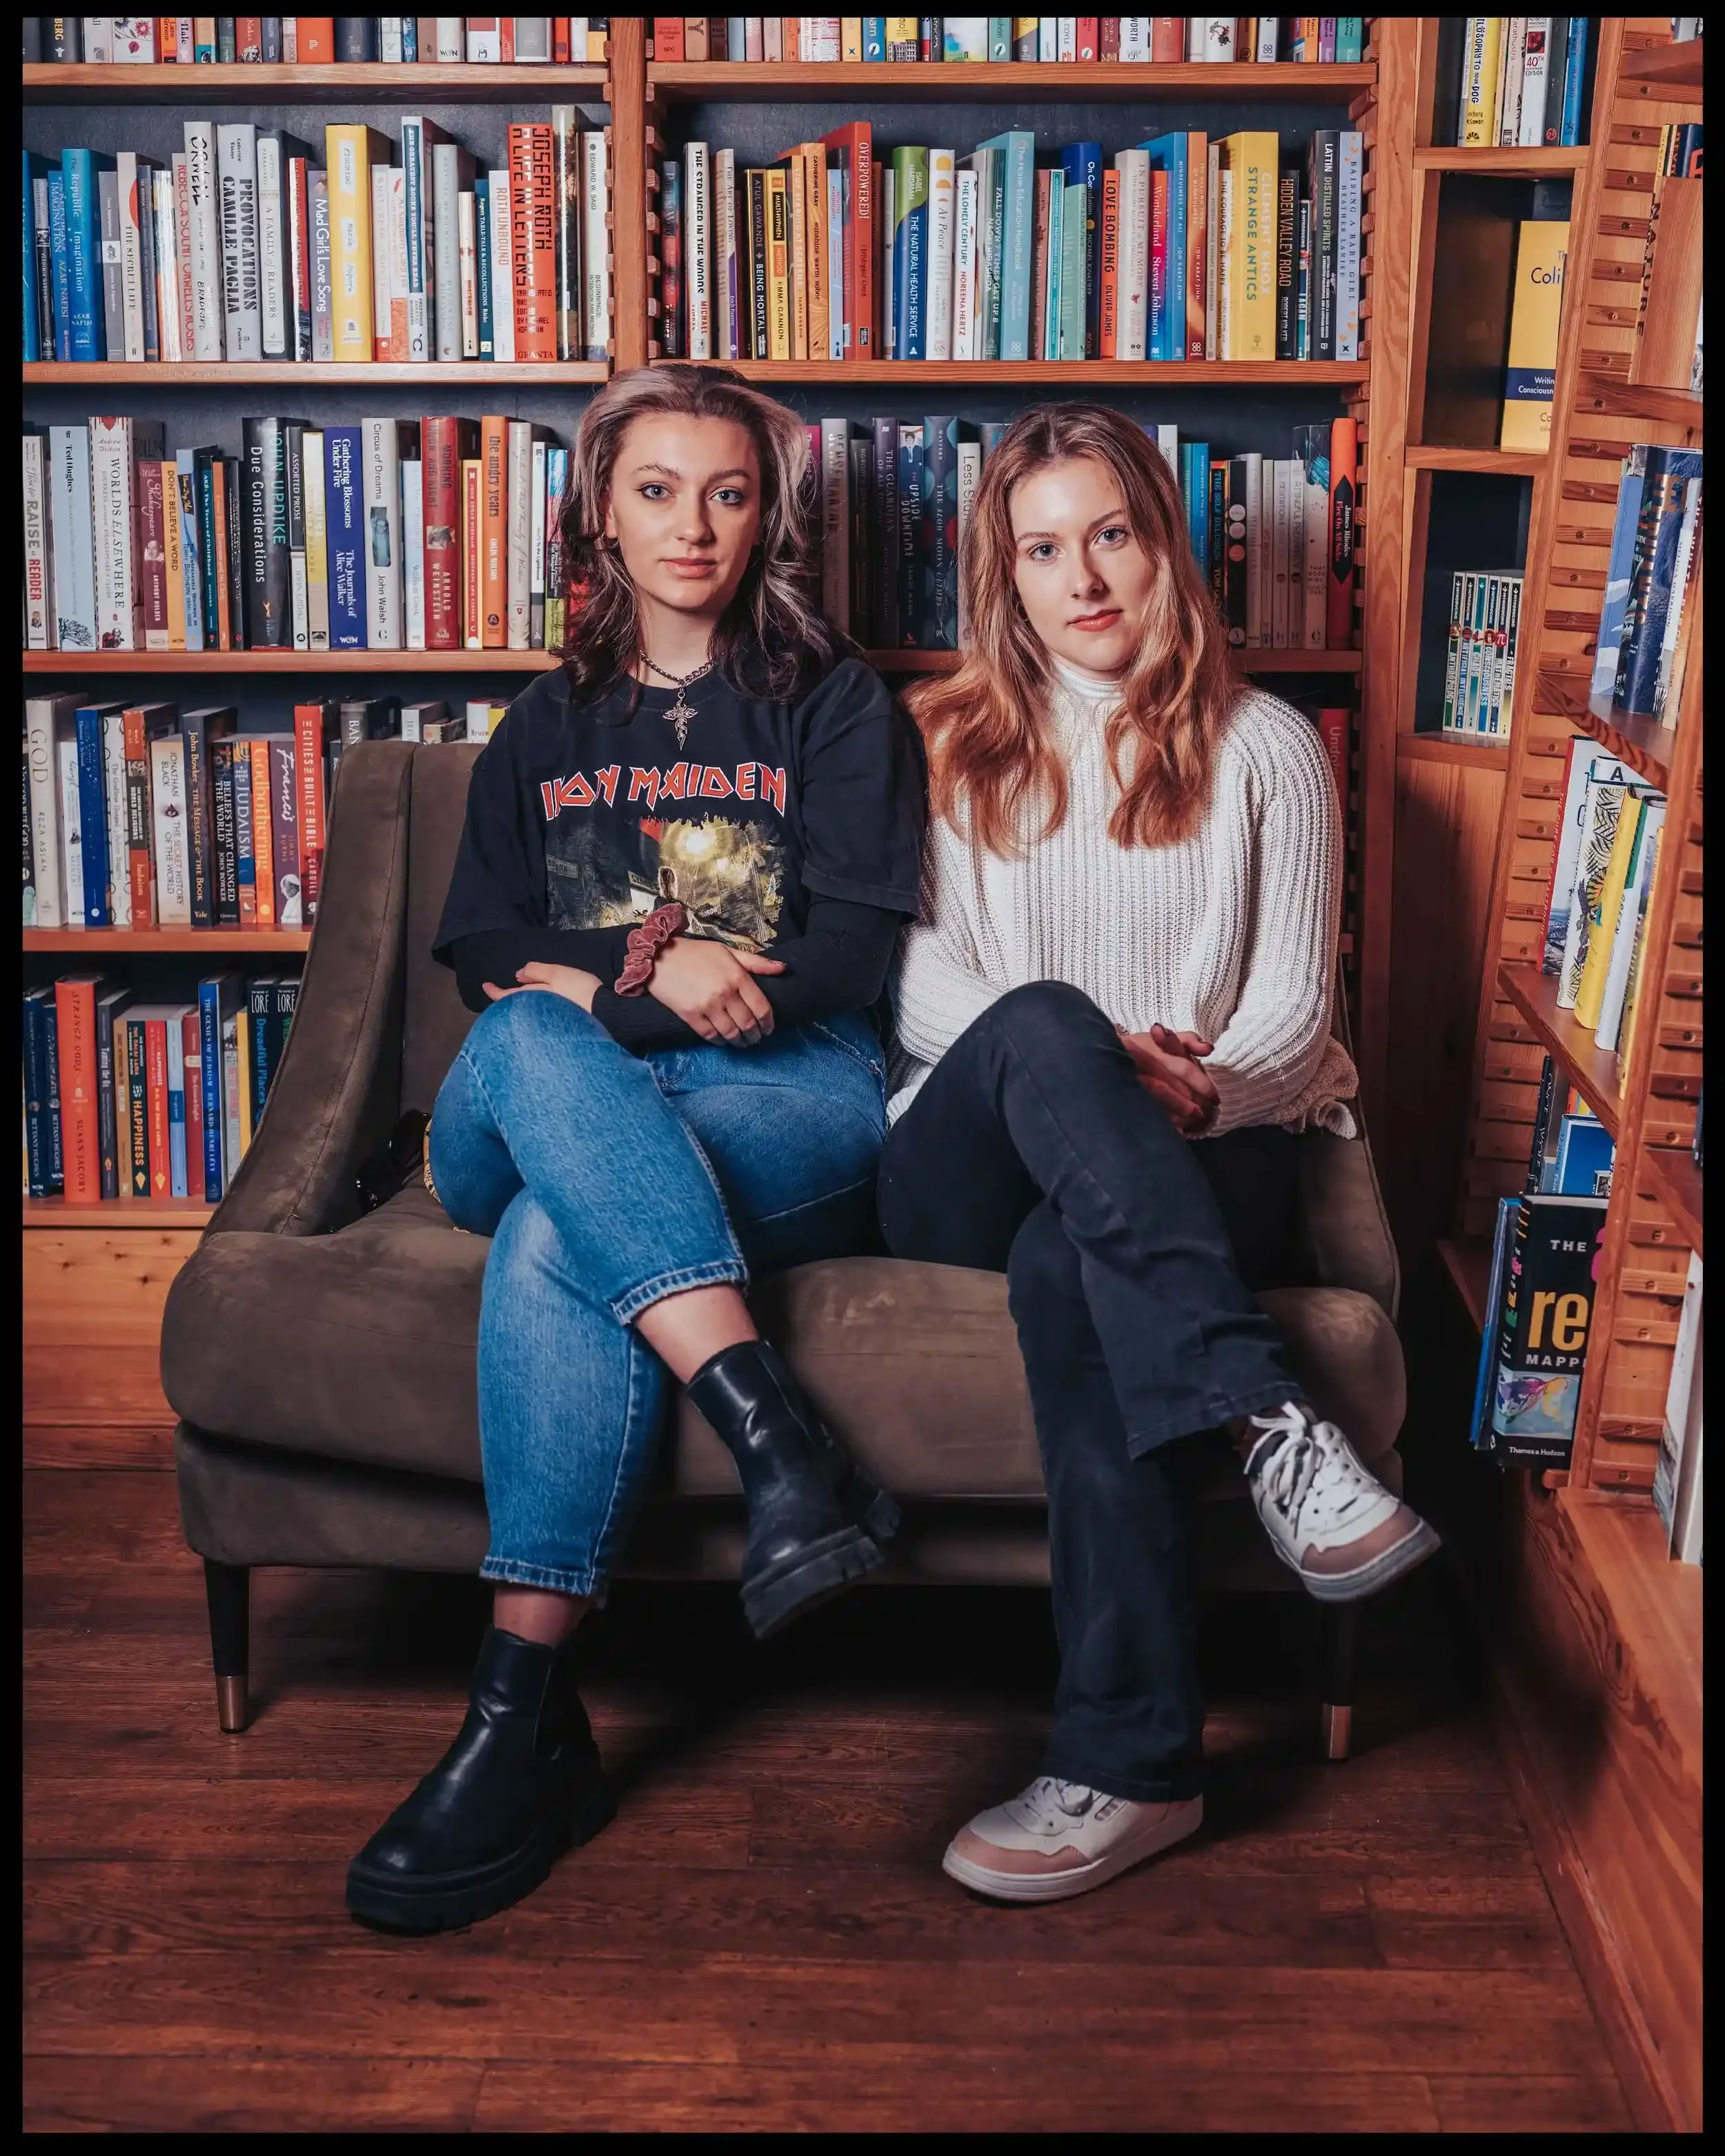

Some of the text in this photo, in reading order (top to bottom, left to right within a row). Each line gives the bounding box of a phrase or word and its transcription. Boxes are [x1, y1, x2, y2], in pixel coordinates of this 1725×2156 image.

[1474, 61, 1481, 70] TO
[409, 146, 417, 185] GREATEST
[532, 128, 552, 250] JOSEPH ROTH
[858, 142, 870, 219] OVERPOWERED!
[907, 164, 916, 200] HARDMAN
[914, 172, 923, 193] ISABEL
[513, 128, 533, 286] A LIFE IN LETTERS
[755, 204, 763, 247] GAWANDE
[960, 197, 969, 227] LONELY
[1322, 144, 1333, 250] LATTIN DISTILLED SPIRITS
[70, 174, 84, 292] Republic Imagination
[223, 176, 239, 313] CAMILLE PAGLIA
[239, 179, 257, 310] PROVOCATIONS
[315, 199, 331, 312] Mad Girl's Love Song
[938, 208, 948, 249] At Peace
[960, 228, 969, 265] CENTURY
[1246, 167, 1258, 301] STRANGE ANTICS
[1261, 172, 1272, 295] CLEMENT KNOX
[1279, 179, 1294, 286] HIDDEN VALLEY ROAD
[126, 248, 135, 284] SECRET
[345, 264, 355, 292] Popova
[756, 264, 764, 290] BEING
[909, 216, 918, 337] THE NATURAL HEALTH SERVICE
[1103, 179, 1116, 337] LOVE BOMBING OLIVER JAMES
[1151, 185, 1162, 335] Wonderland Steven Johnson
[757, 295, 765, 331] MORTAL
[65, 462, 74, 493] Hughes
[168, 471, 176, 498] DON'T
[292, 453, 300, 493] ASSORTED
[333, 439, 343, 487] Under Fire
[340, 439, 353, 528] Gathering Blossoms
[487, 436, 501, 517] the angry years
[963, 456, 975, 484] Less
[110, 458, 125, 609] WORLDS ELSEWHERE
[169, 500, 177, 533] BELIEVE
[250, 447, 266, 582] Due Considerations
[373, 424, 387, 623] Circus of Dreams John Walsh
[27, 500, 42, 600] RAISE READER
[170, 544, 179, 571] WORD
[1343, 531, 1352, 557] Rhodes
[336, 550, 346, 606] Alice Walker
[346, 550, 357, 617] The Journals of
[432, 563, 441, 620] WEINSTEIN
[442, 572, 451, 611] ARNOLD
[1446, 652, 1457, 703] ANTHROPOLOGY
[1481, 646, 1492, 706] CONSCIOUSNESS
[1492, 658, 1503, 707] MATHEMATICS
[1506, 656, 1514, 690] FRACTALS
[30, 729, 49, 783] GOD
[188, 730, 199, 782] John Bowker
[215, 781, 225, 841] THE WORLD
[253, 748, 272, 869] Godbothering
[276, 749, 295, 822] Francis
[302, 731, 316, 847] CITIES BUILT BIBLE
[627, 762, 787, 818] MAIDEN
[37, 812, 48, 872] REZA ASLAN
[224, 781, 235, 902] BELIEFS THAT CHANGED
[236, 787, 250, 859] JUDAISM
[251, 994, 269, 1013] LORE
[256, 1018, 268, 1103] Dreadful Places
[77, 1119, 85, 1194] SUSAN JACOBY
[132, 1100, 144, 1166] HAPPINESS
[1550, 1240, 1586, 1252] THE
[1540, 1448, 1565, 1456] Hudson
